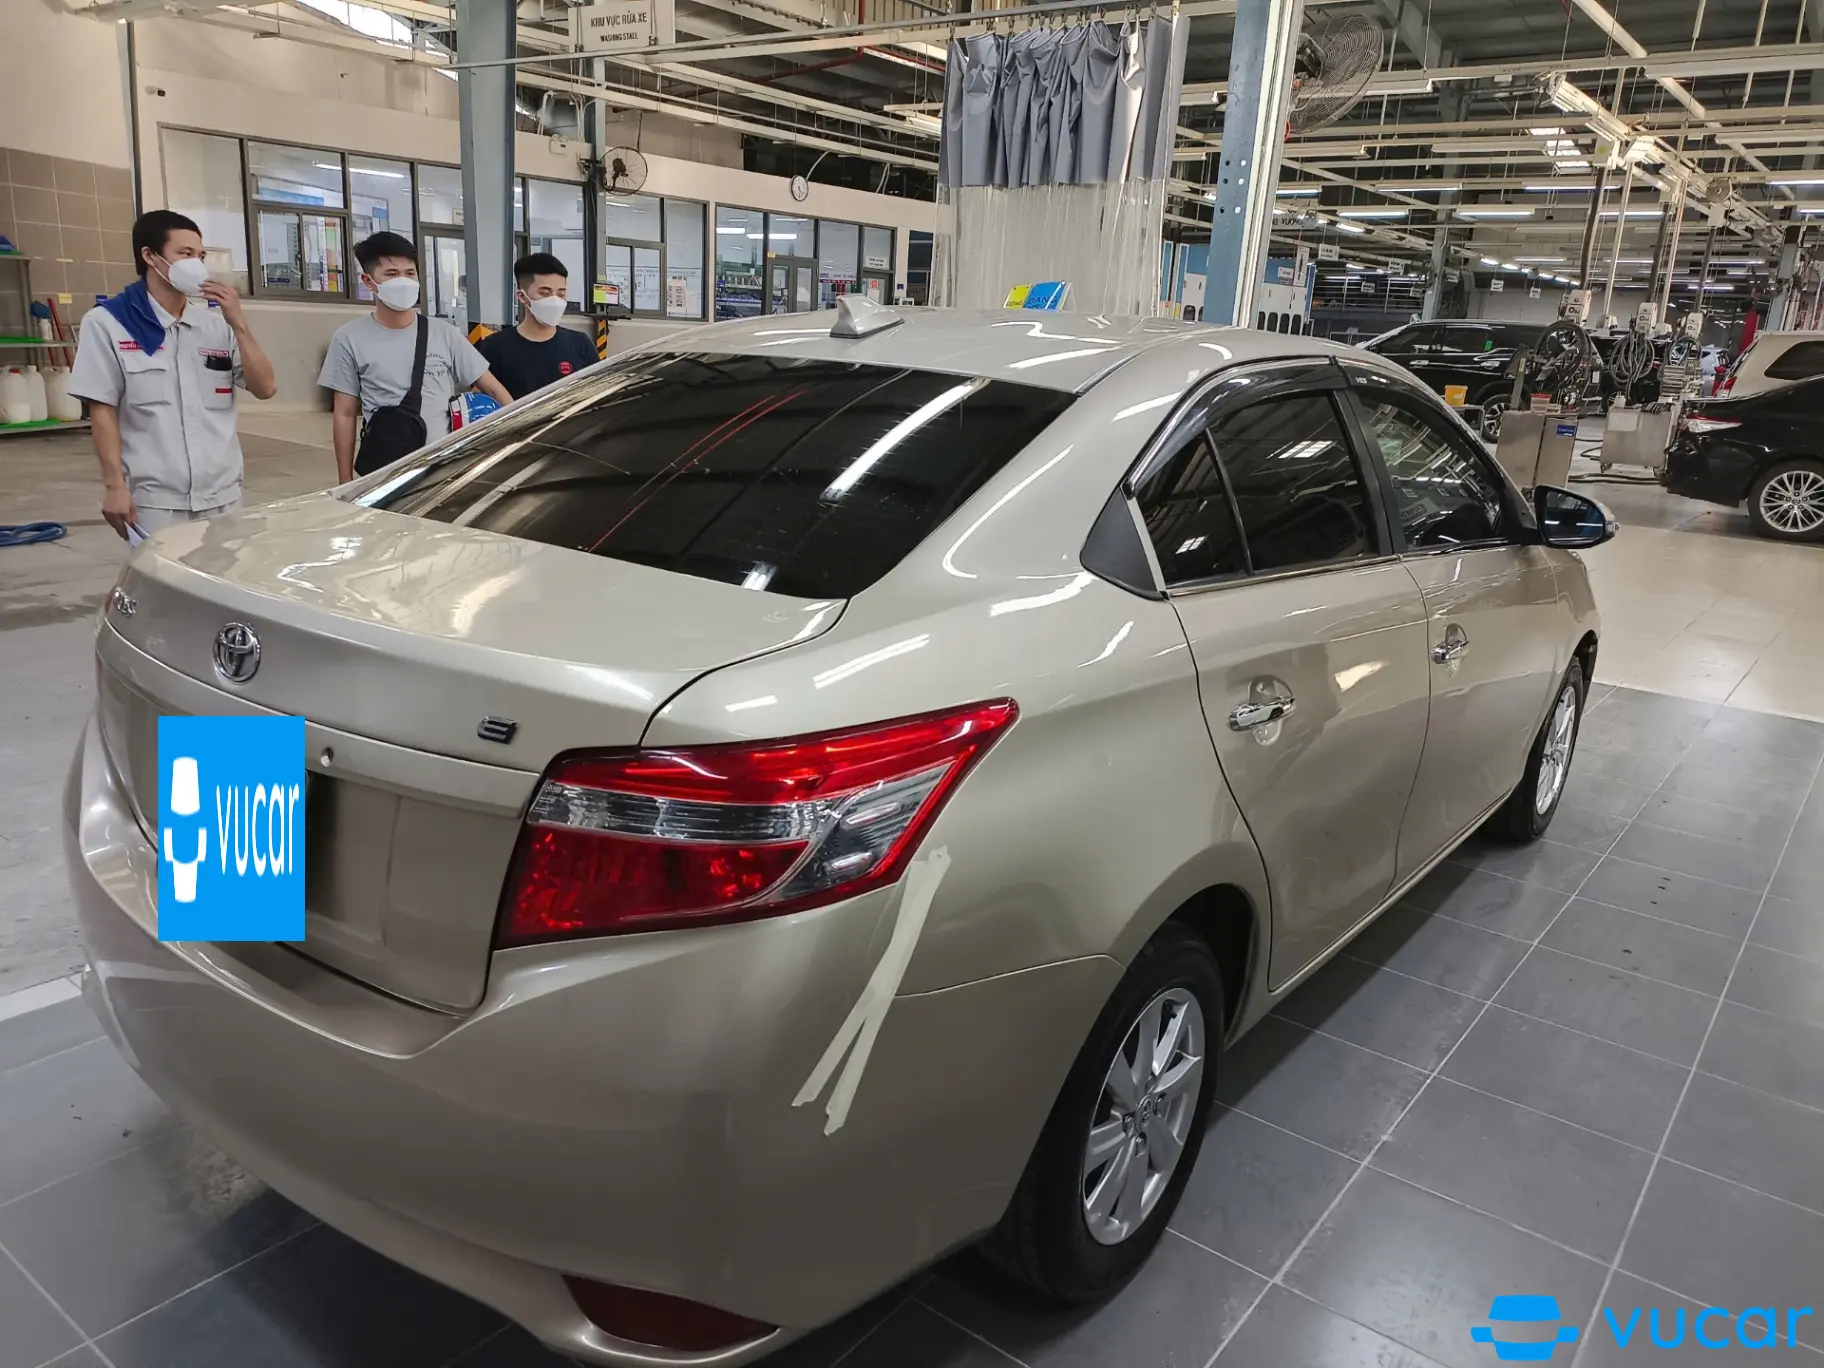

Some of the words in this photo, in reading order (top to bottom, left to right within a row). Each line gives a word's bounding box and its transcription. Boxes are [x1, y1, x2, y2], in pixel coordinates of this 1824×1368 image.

[590, 16, 605, 28] KHU
[638, 12, 648, 23] XE
[600, 33, 622, 42] WASHING
[623, 32, 638, 41] STALL
